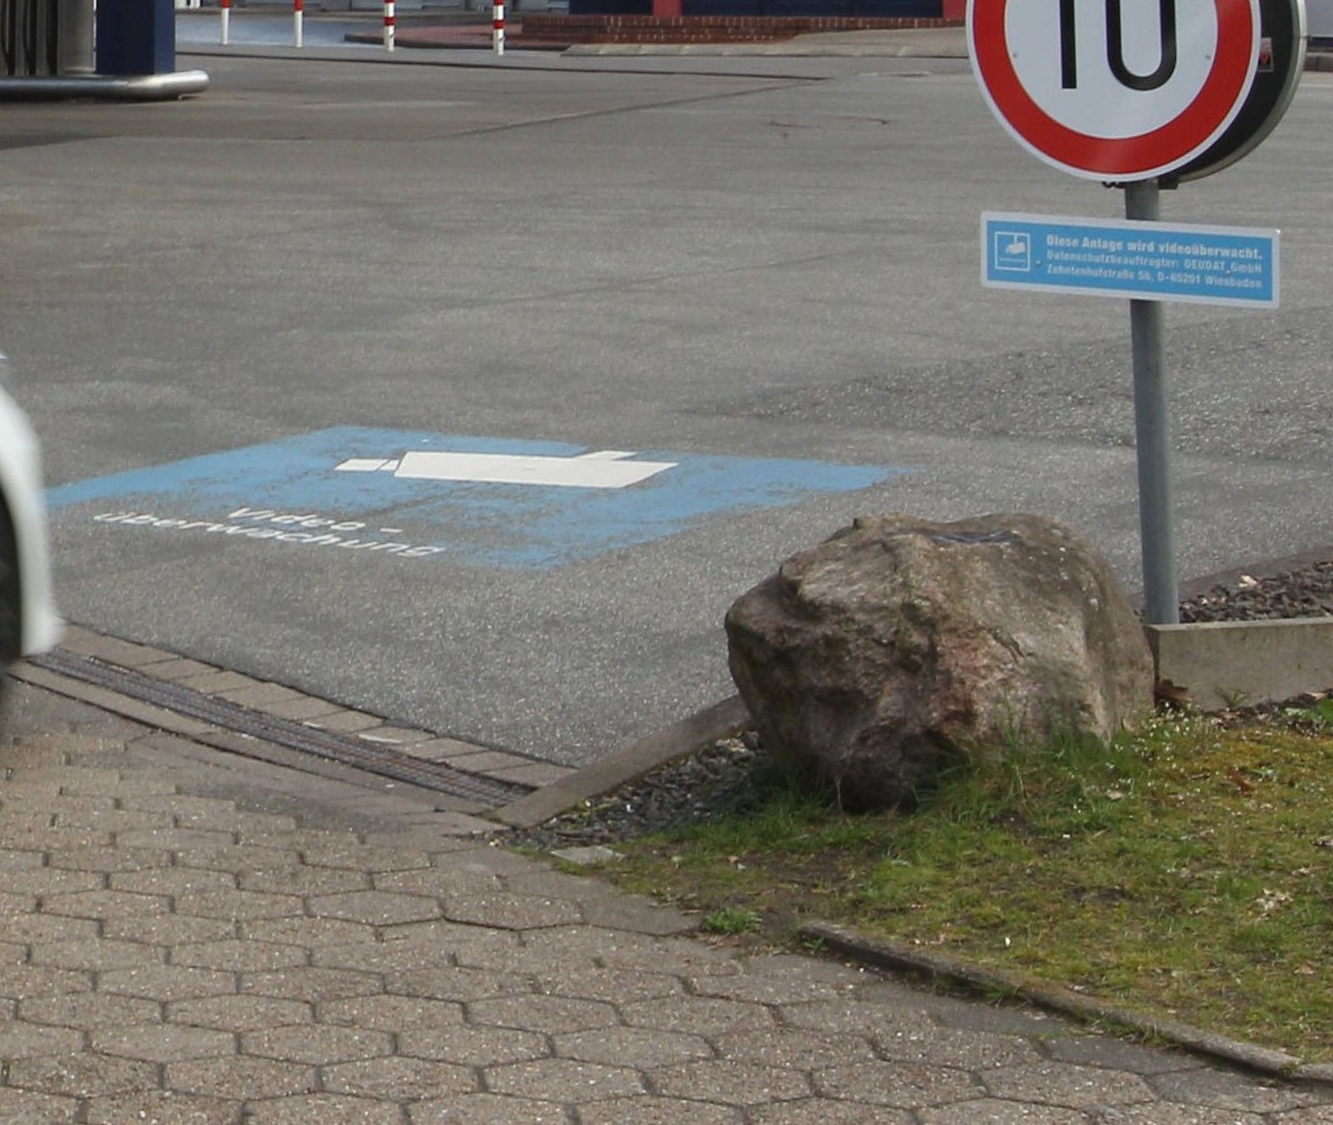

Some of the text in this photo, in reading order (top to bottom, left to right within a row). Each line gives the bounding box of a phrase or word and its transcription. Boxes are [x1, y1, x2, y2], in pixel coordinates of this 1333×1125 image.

[1046, 234, 1079, 248] Diese
[1082, 236, 1124, 253] Anlage
[1127, 240, 1154, 252] wird
